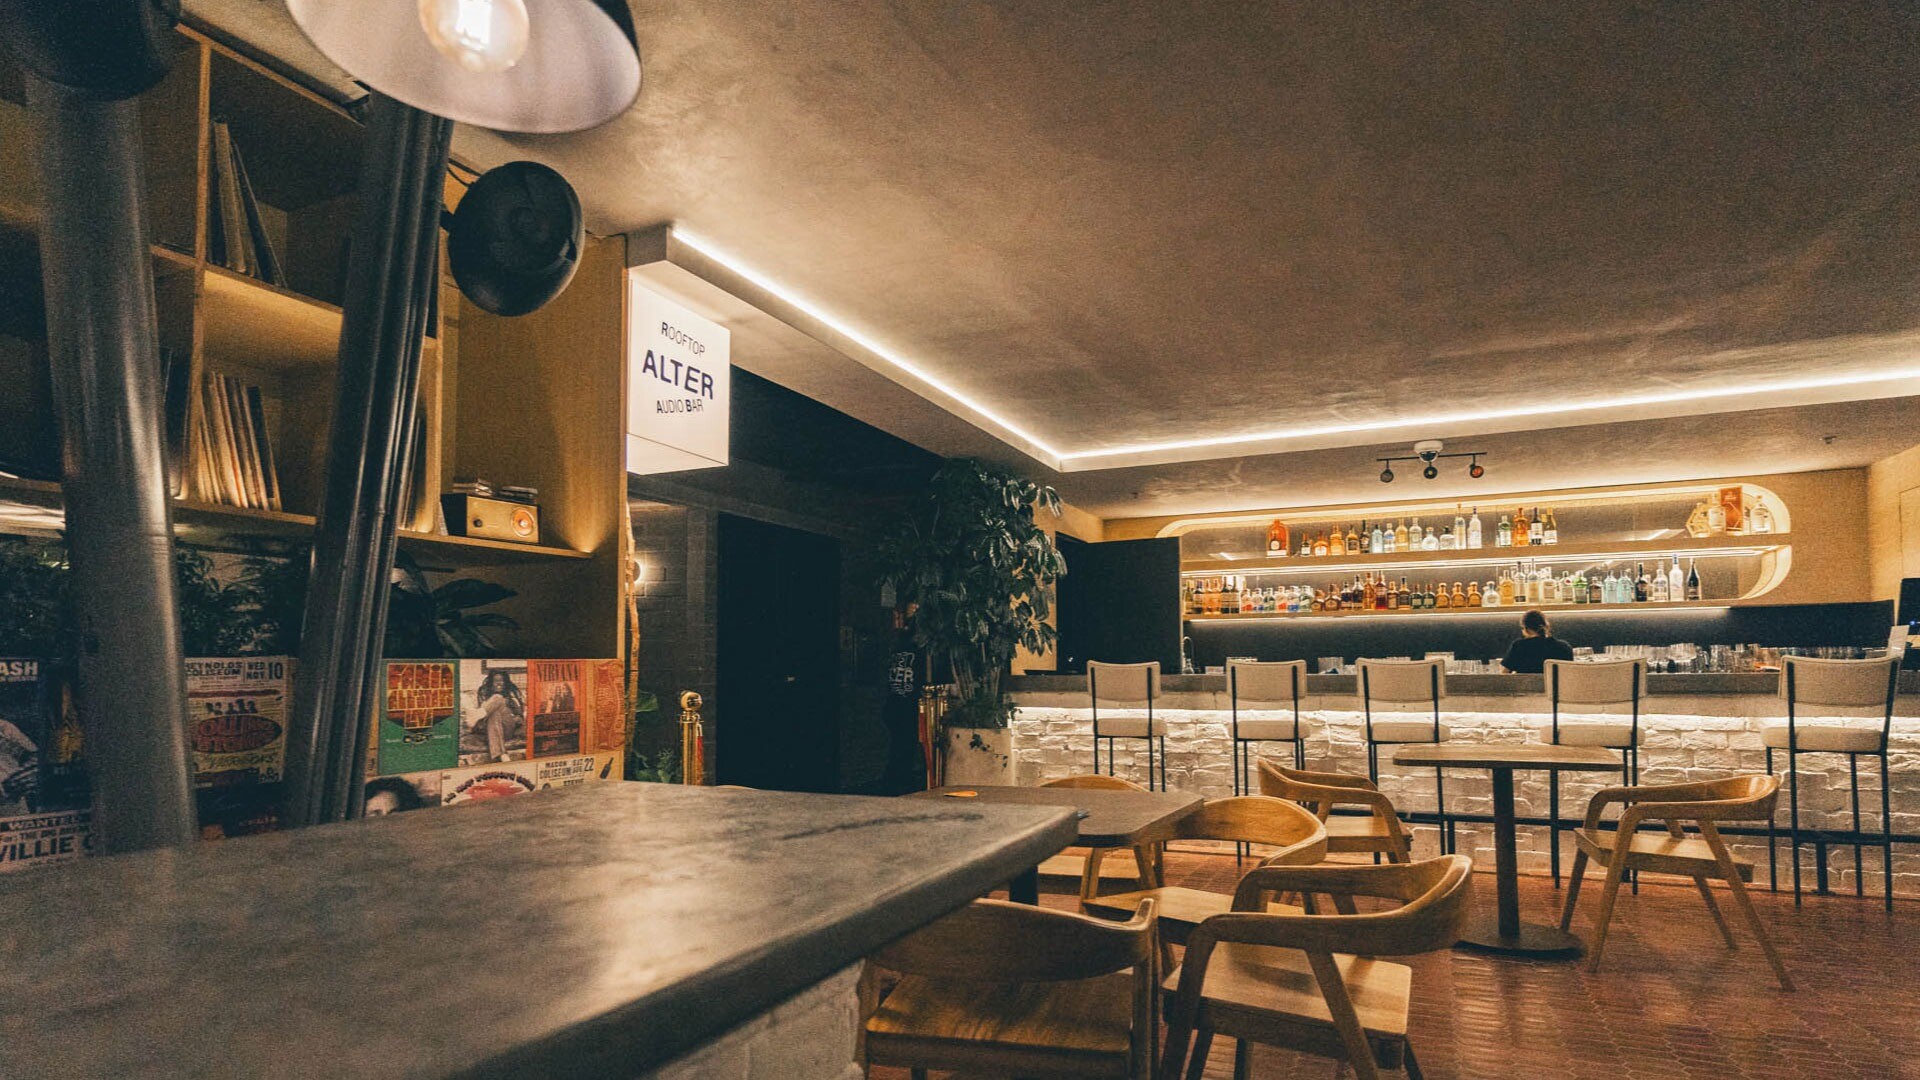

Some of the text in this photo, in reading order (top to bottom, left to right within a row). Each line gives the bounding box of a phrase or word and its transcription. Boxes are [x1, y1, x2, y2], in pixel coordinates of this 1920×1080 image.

[661, 321, 706, 358] ROOFTOP
[642, 349, 714, 400] ALTER
[656, 398, 704, 414] AUDIO BAR
[268, 662, 283, 680] 10
[537, 663, 578, 682] NIRVANA
[539, 767, 571, 779] COLISEUM
[584, 757, 594, 771] 22
